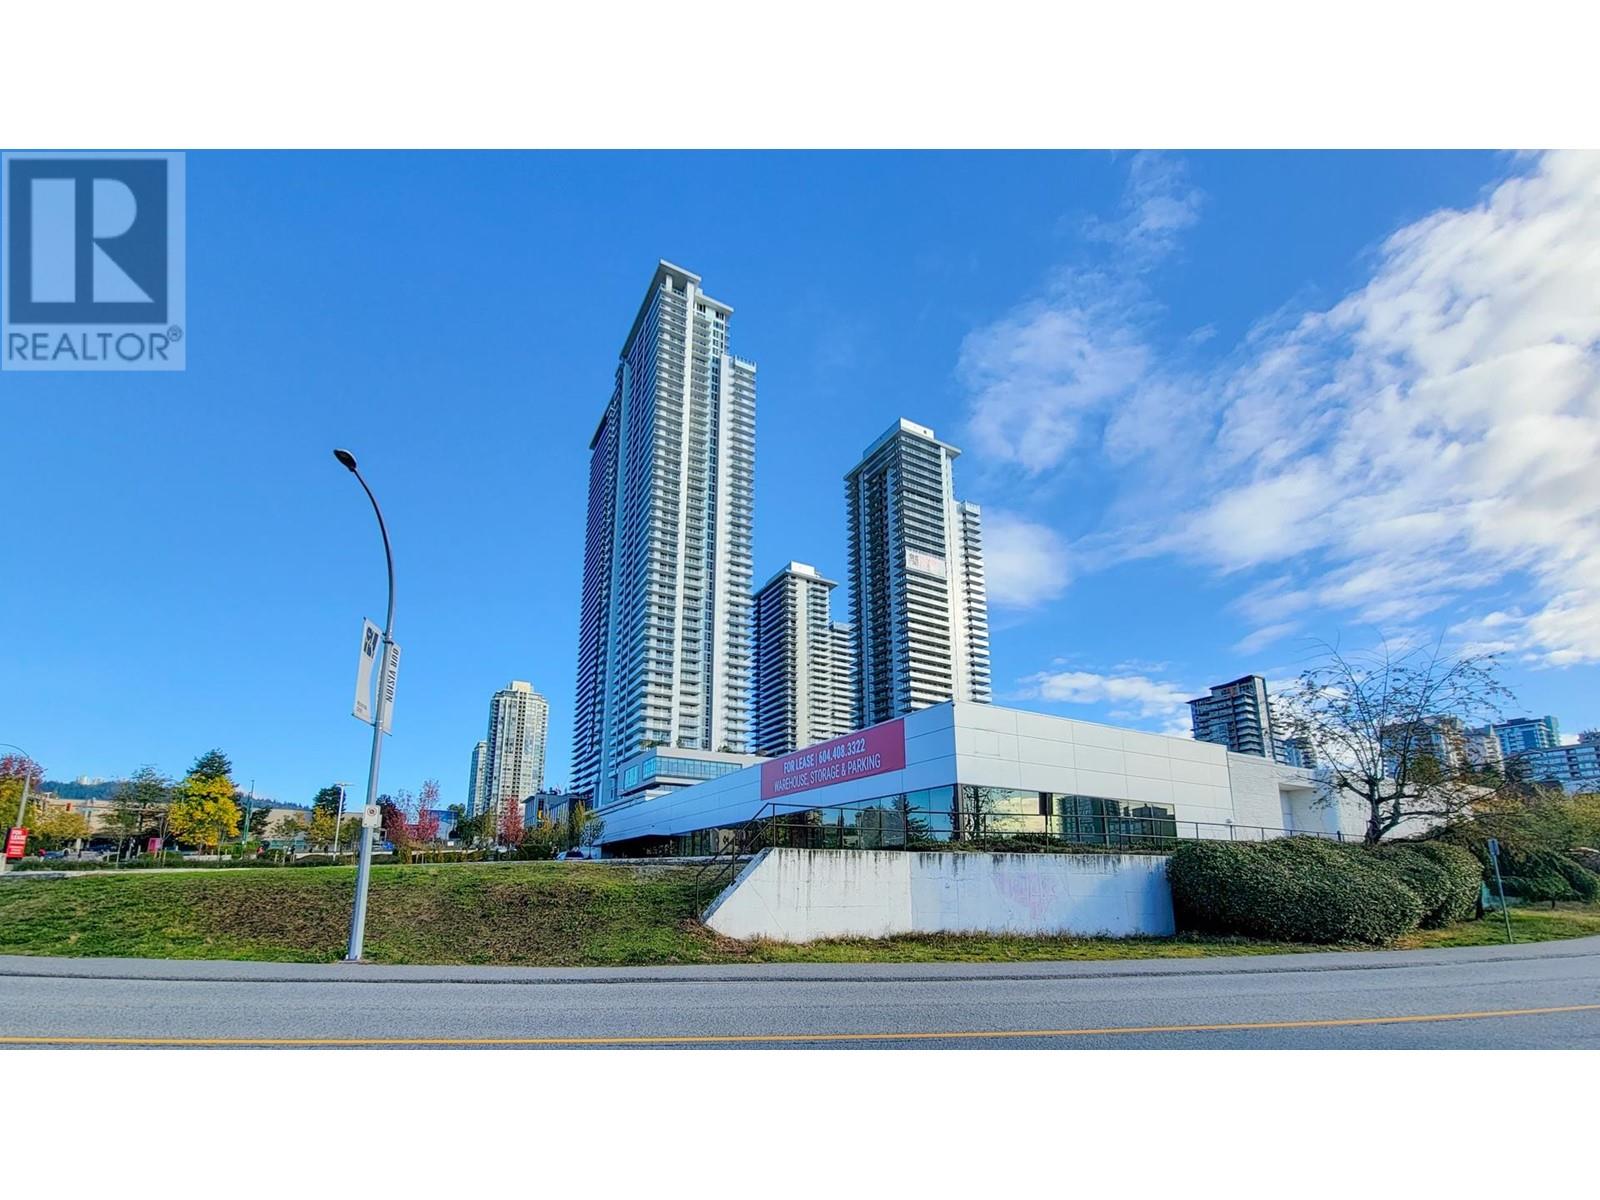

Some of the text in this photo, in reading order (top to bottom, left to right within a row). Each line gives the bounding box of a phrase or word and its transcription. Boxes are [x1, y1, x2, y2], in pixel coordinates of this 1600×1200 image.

[385, 670, 397, 703] VISION
[783, 760, 795, 774] FOR
[796, 753, 814, 770] LEASE
[818, 738, 866, 764] 604.408.3322
[810, 765, 840, 784] STORAGE
[841, 762, 846, 776] &
[847, 753, 881, 775] PARKING
